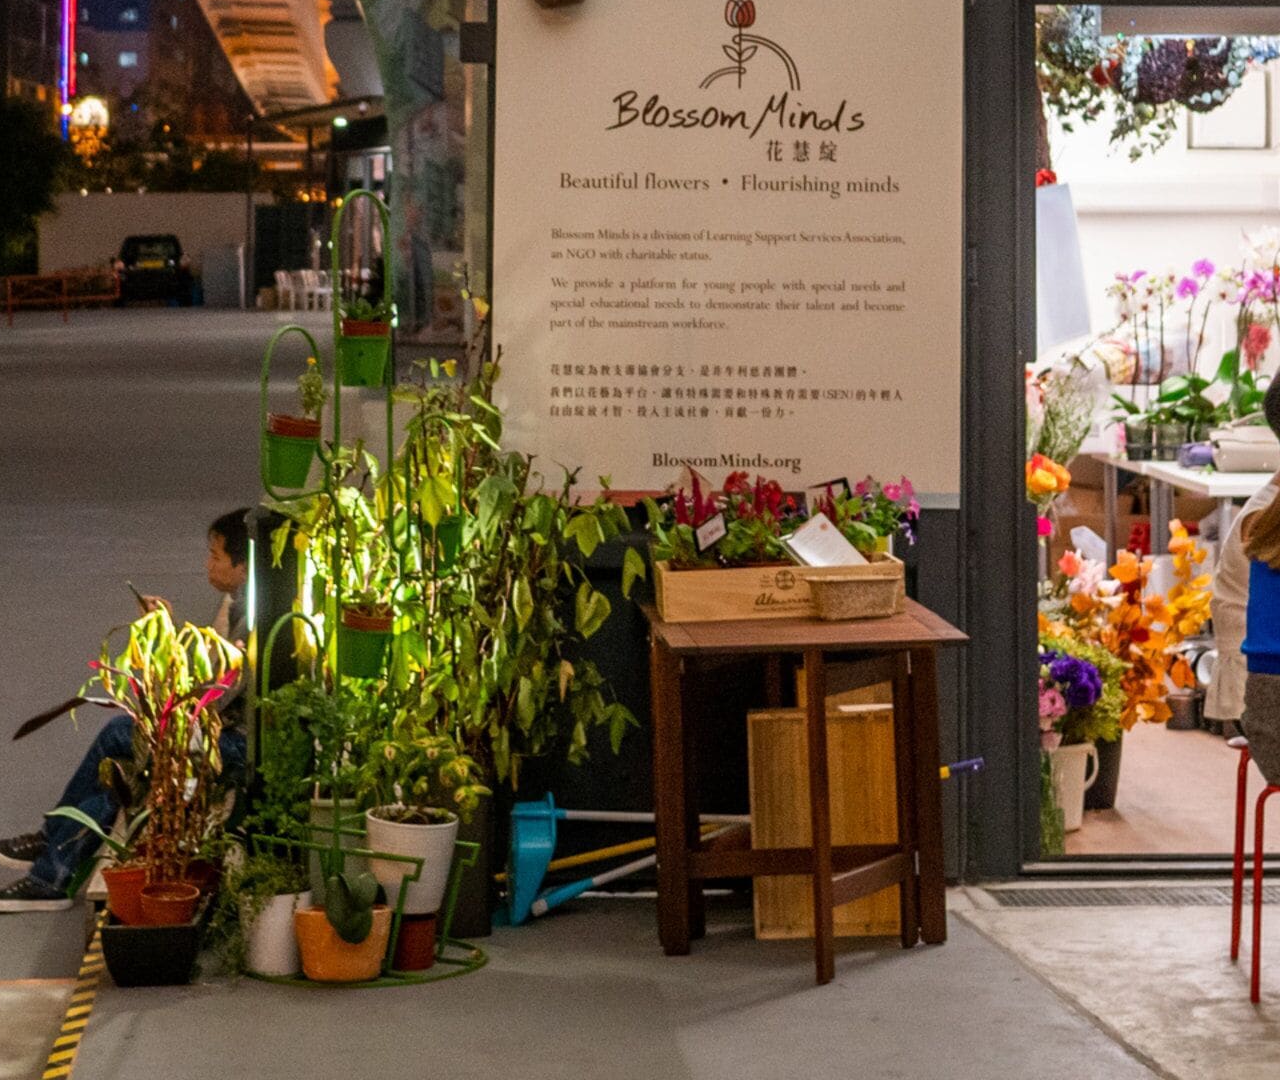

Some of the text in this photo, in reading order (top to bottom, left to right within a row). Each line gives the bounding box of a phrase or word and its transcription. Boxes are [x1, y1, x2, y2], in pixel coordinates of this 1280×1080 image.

[607, 90, 865, 138] Blossom Minds
[767, 140, 837, 162] 花慧綻
[560, 172, 899, 199] Beautiful flowers Flourishing minds
[551, 228, 595, 239] Blossom
[598, 229, 630, 240] Minds
[632, 232, 640, 240] is
[650, 229, 691, 240] division
[693, 229, 705, 241] of
[706, 230, 752, 246] Learning
[755, 232, 796, 245] Support
[800, 232, 842, 242] Services
[842, 232, 905, 244] Association,
[567, 249, 596, 259] NGO
[600, 248, 623, 259] with
[626, 248, 676, 260] charitable
[551, 277, 568, 288] We
[574, 278, 613, 292] provide
[630, 278, 676, 293] platform
[682, 278, 697, 289] for
[704, 282, 735, 294] young
[741, 279, 775, 294] people
[782, 279, 806, 290] with
[811, 280, 845, 294] special
[851, 281, 881, 291] needs
[886, 281, 905, 292] and
[551, 297, 905, 312] special educational needs to demonstrate their talent and become
[550, 319, 572, 331] part
[575, 317, 587, 327] of
[589, 317, 604, 328] the
[608, 320, 669, 329] mainstream
[652, 452, 801, 471] BlossomMinds.org
